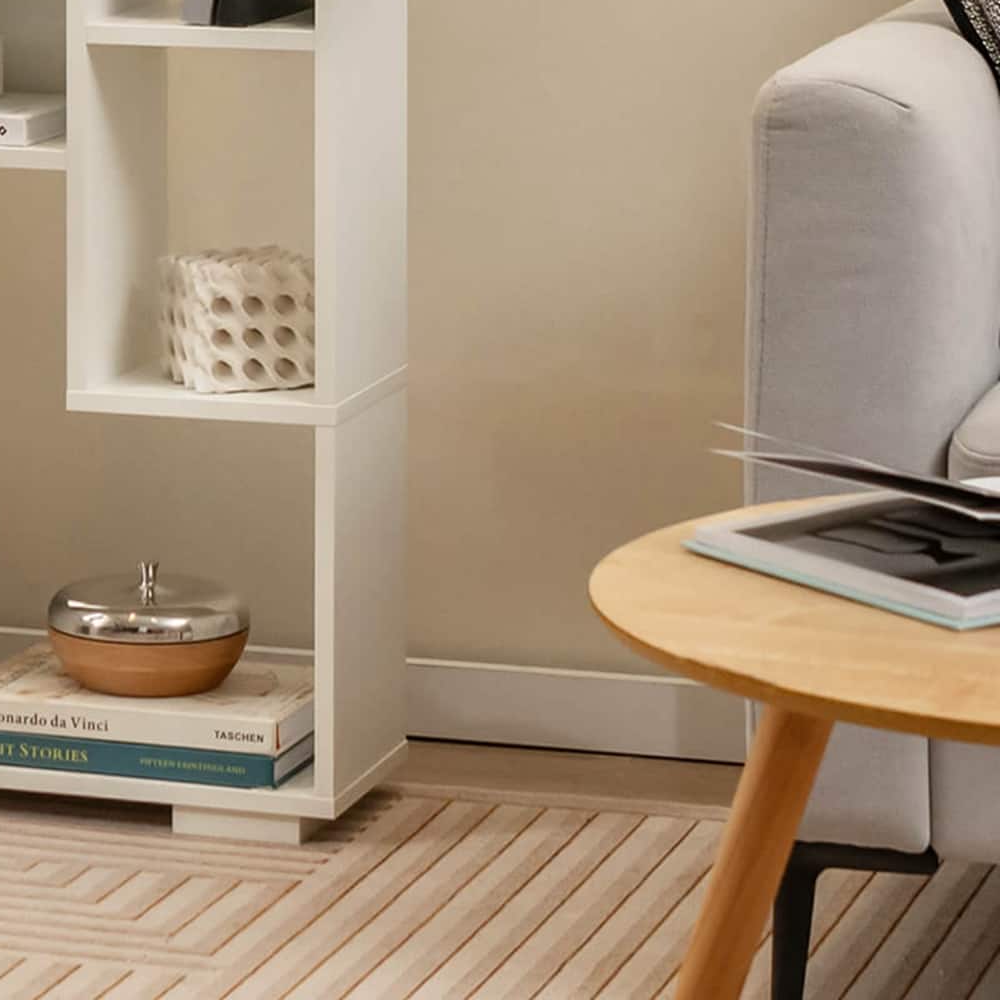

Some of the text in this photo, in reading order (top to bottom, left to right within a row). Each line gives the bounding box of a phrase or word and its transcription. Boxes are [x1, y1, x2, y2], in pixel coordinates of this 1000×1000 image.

[50, 715, 67, 729] da
[72, 716, 110, 733] Vinci
[214, 730, 265, 744] TASCHEN
[19, 741, 89, 764] STORIES
